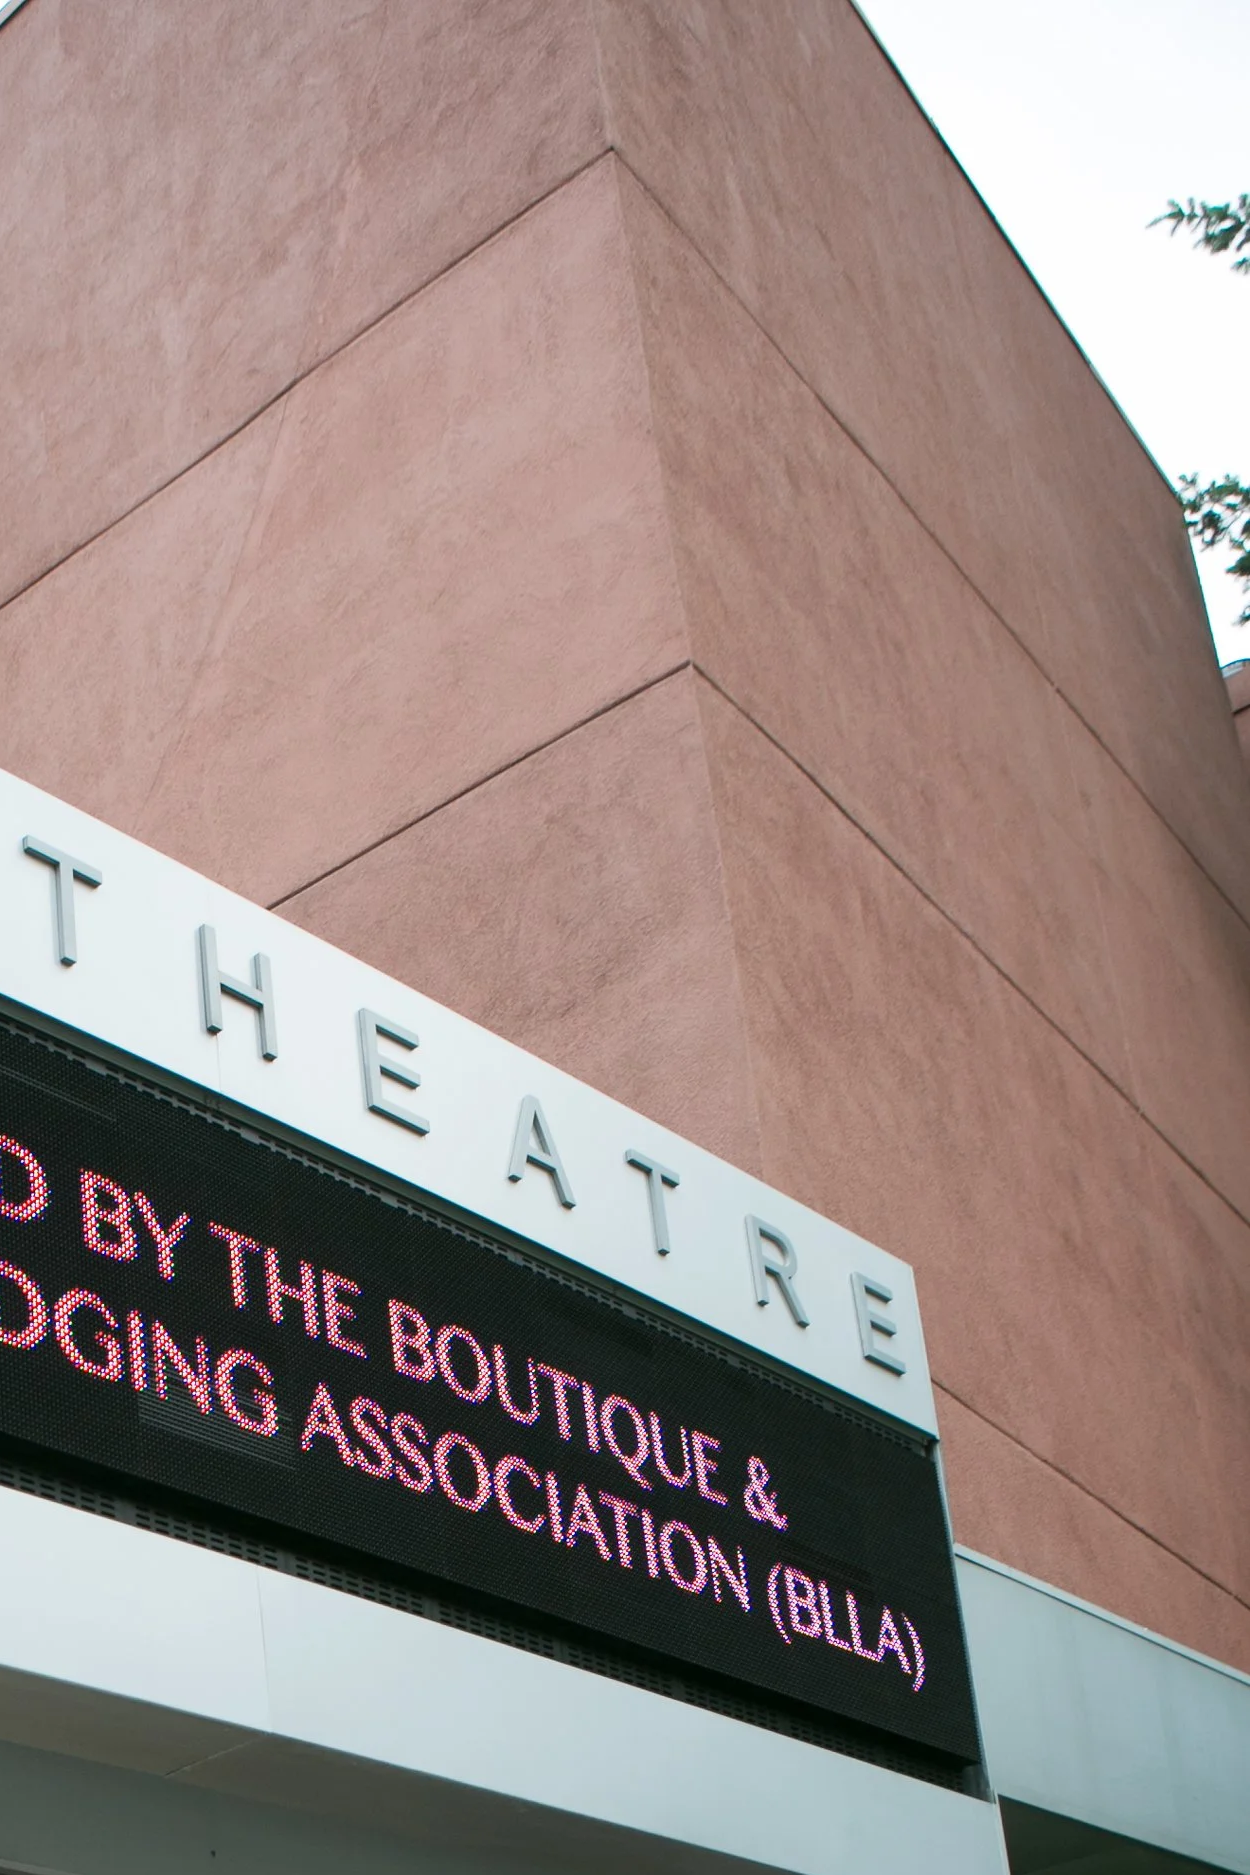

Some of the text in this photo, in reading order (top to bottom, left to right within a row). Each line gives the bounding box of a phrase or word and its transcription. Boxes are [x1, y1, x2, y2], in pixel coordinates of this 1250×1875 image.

[21, 834, 906, 1376] THEATRE
[80, 1169, 190, 1280] BY
[210, 1222, 367, 1358] THE
[389, 1300, 724, 1506] BOUTIQUE
[744, 1456, 788, 1530] &
[302, 1383, 750, 1612] ASSOCIATION
[768, 1563, 925, 1691] (BLLA)
